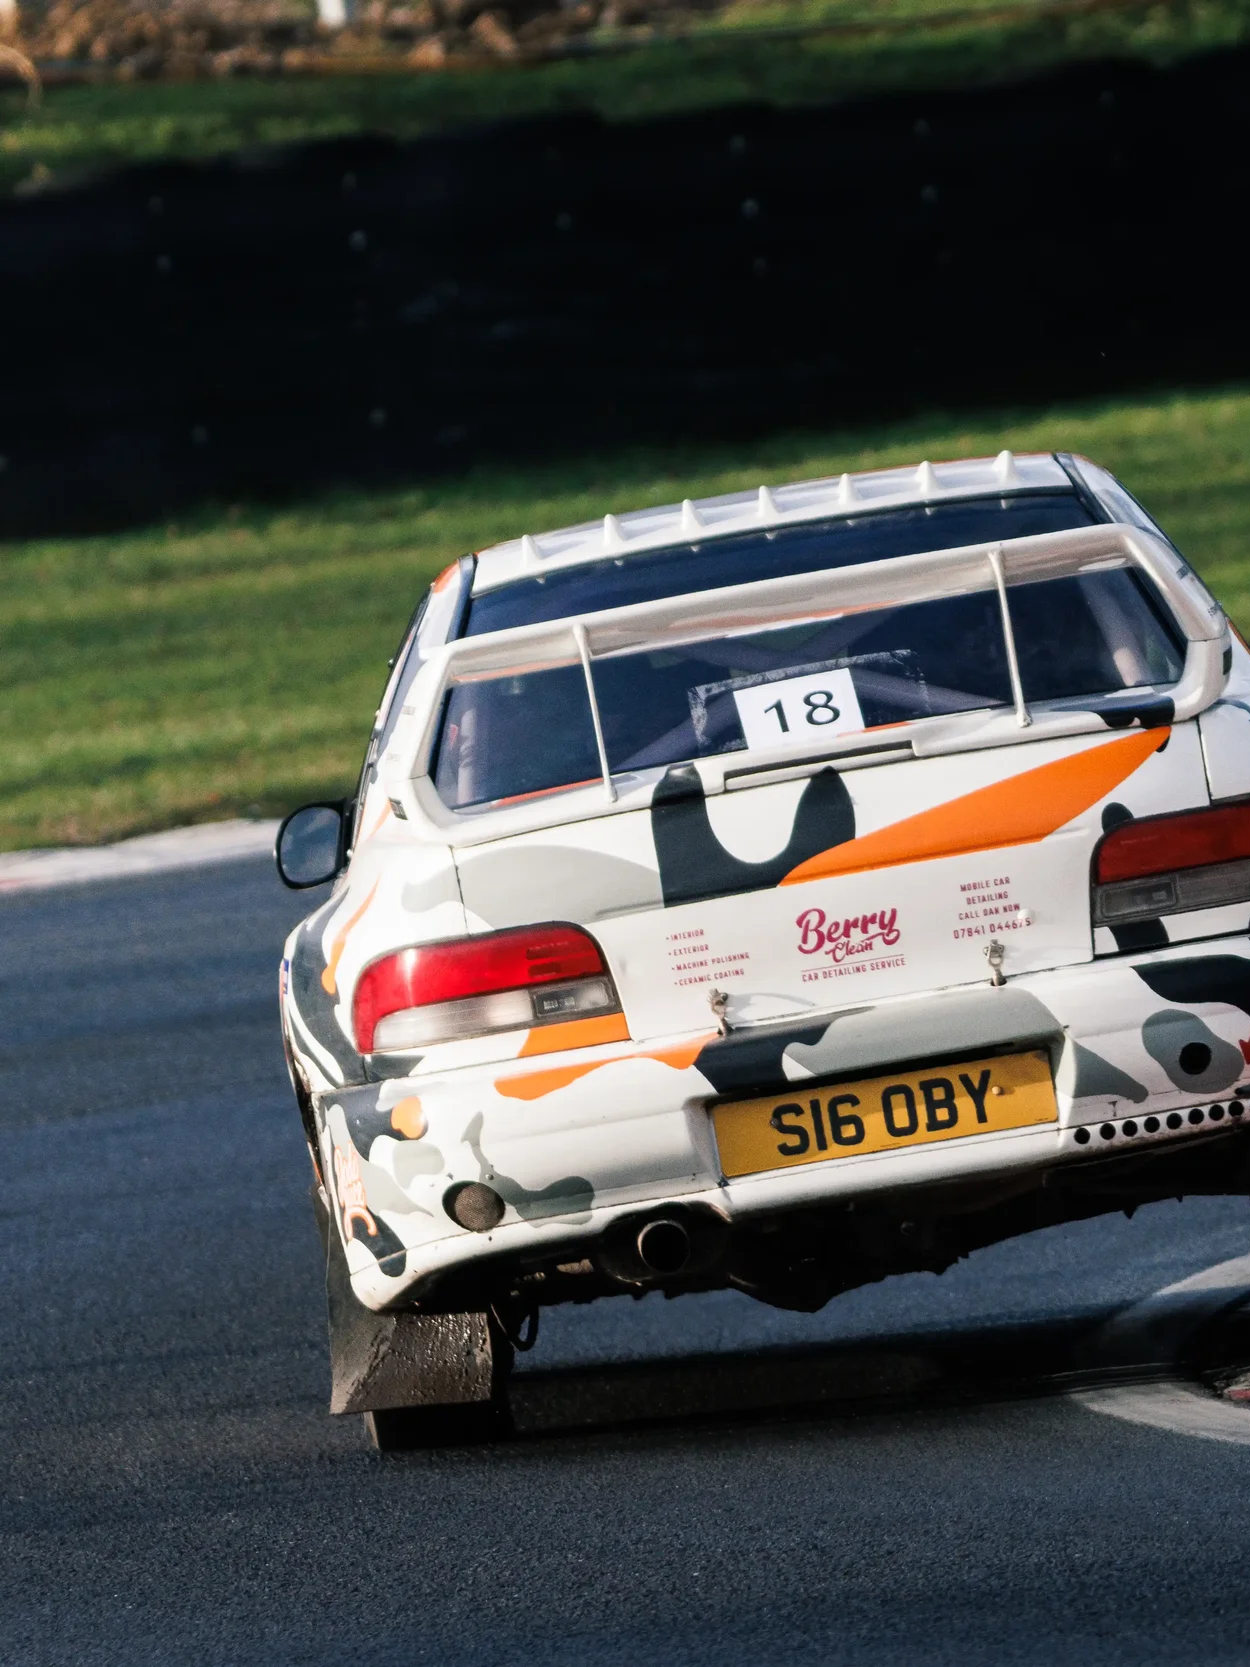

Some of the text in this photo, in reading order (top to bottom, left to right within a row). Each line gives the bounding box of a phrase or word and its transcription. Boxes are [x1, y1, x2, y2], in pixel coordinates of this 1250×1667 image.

[764, 689, 840, 733] 18
[960, 876, 1010, 892] MOBILE CAR
[966, 891, 1008, 905] DETAILING
[959, 903, 1020, 920] CALL DAN NOW
[671, 929, 704, 940] INTERIOR
[796, 908, 900, 954] Berry
[953, 925, 986, 939] 07841
[673, 944, 709, 956] EXTERIOR
[825, 940, 873, 963] Clean
[676, 952, 750, 970] MACHINE POLISHING
[679, 968, 744, 985] CERAMIC COATING
[802, 958, 906, 982] CAR DETAILING SERVICE
[772, 1069, 991, 1156] S16 OBY
